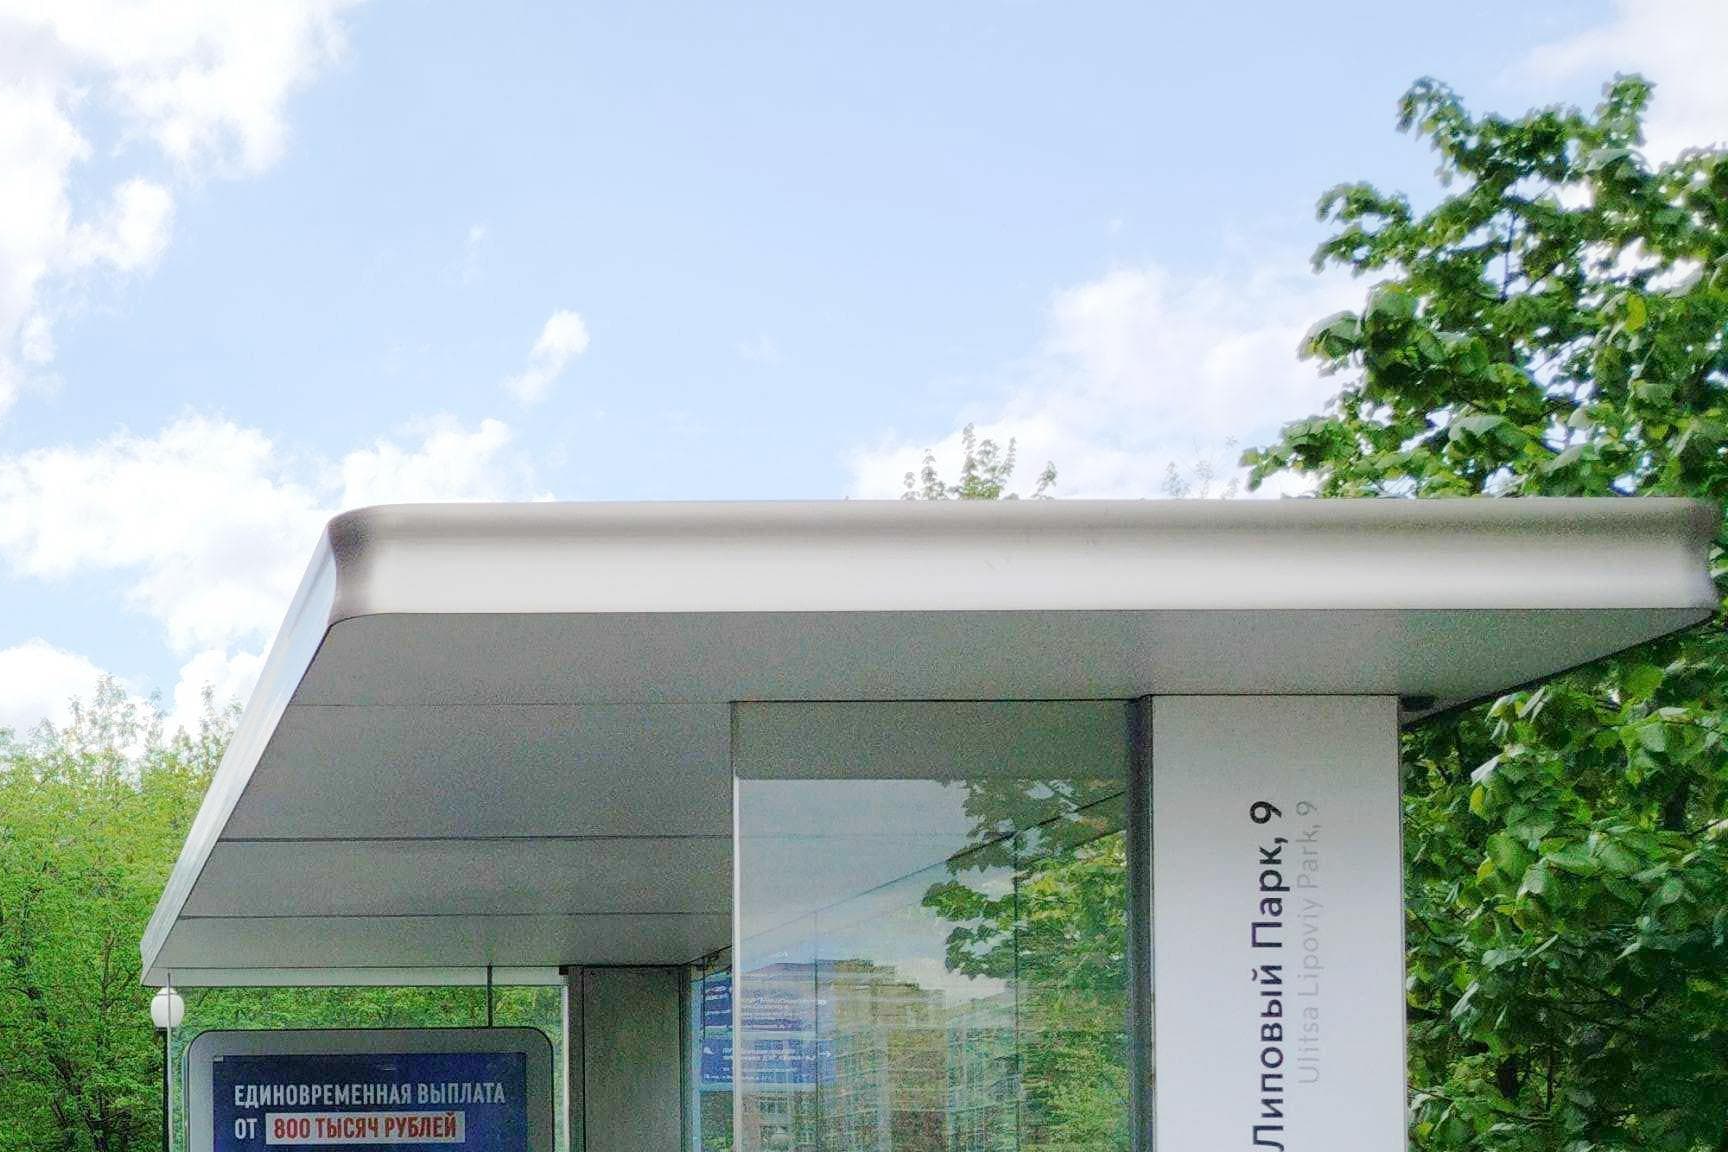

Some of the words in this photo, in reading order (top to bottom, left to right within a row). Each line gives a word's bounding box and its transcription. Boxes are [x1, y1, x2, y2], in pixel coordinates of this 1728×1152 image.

[1249, 800, 1282, 824] 9
[1296, 801, 1318, 815] 9
[1296, 824, 1322, 889] Park,
[1251, 836, 1290, 948] Парк,
[1297, 898, 1324, 996] Lipoviy
[1251, 964, 1286, 1152] Липовый
[1297, 1006, 1320, 1084] Ulitsa
[234, 1084, 411, 1108] ЕДИНОВРЕМЕННАЯ
[416, 1082, 506, 1104] ВЫПЛАТА
[234, 1118, 258, 1140] ОТ
[274, 1117, 311, 1139] 800
[315, 1116, 379, 1139] ТЫСЯЧ
[384, 1112, 456, 1138] РУБЛЕЙ
